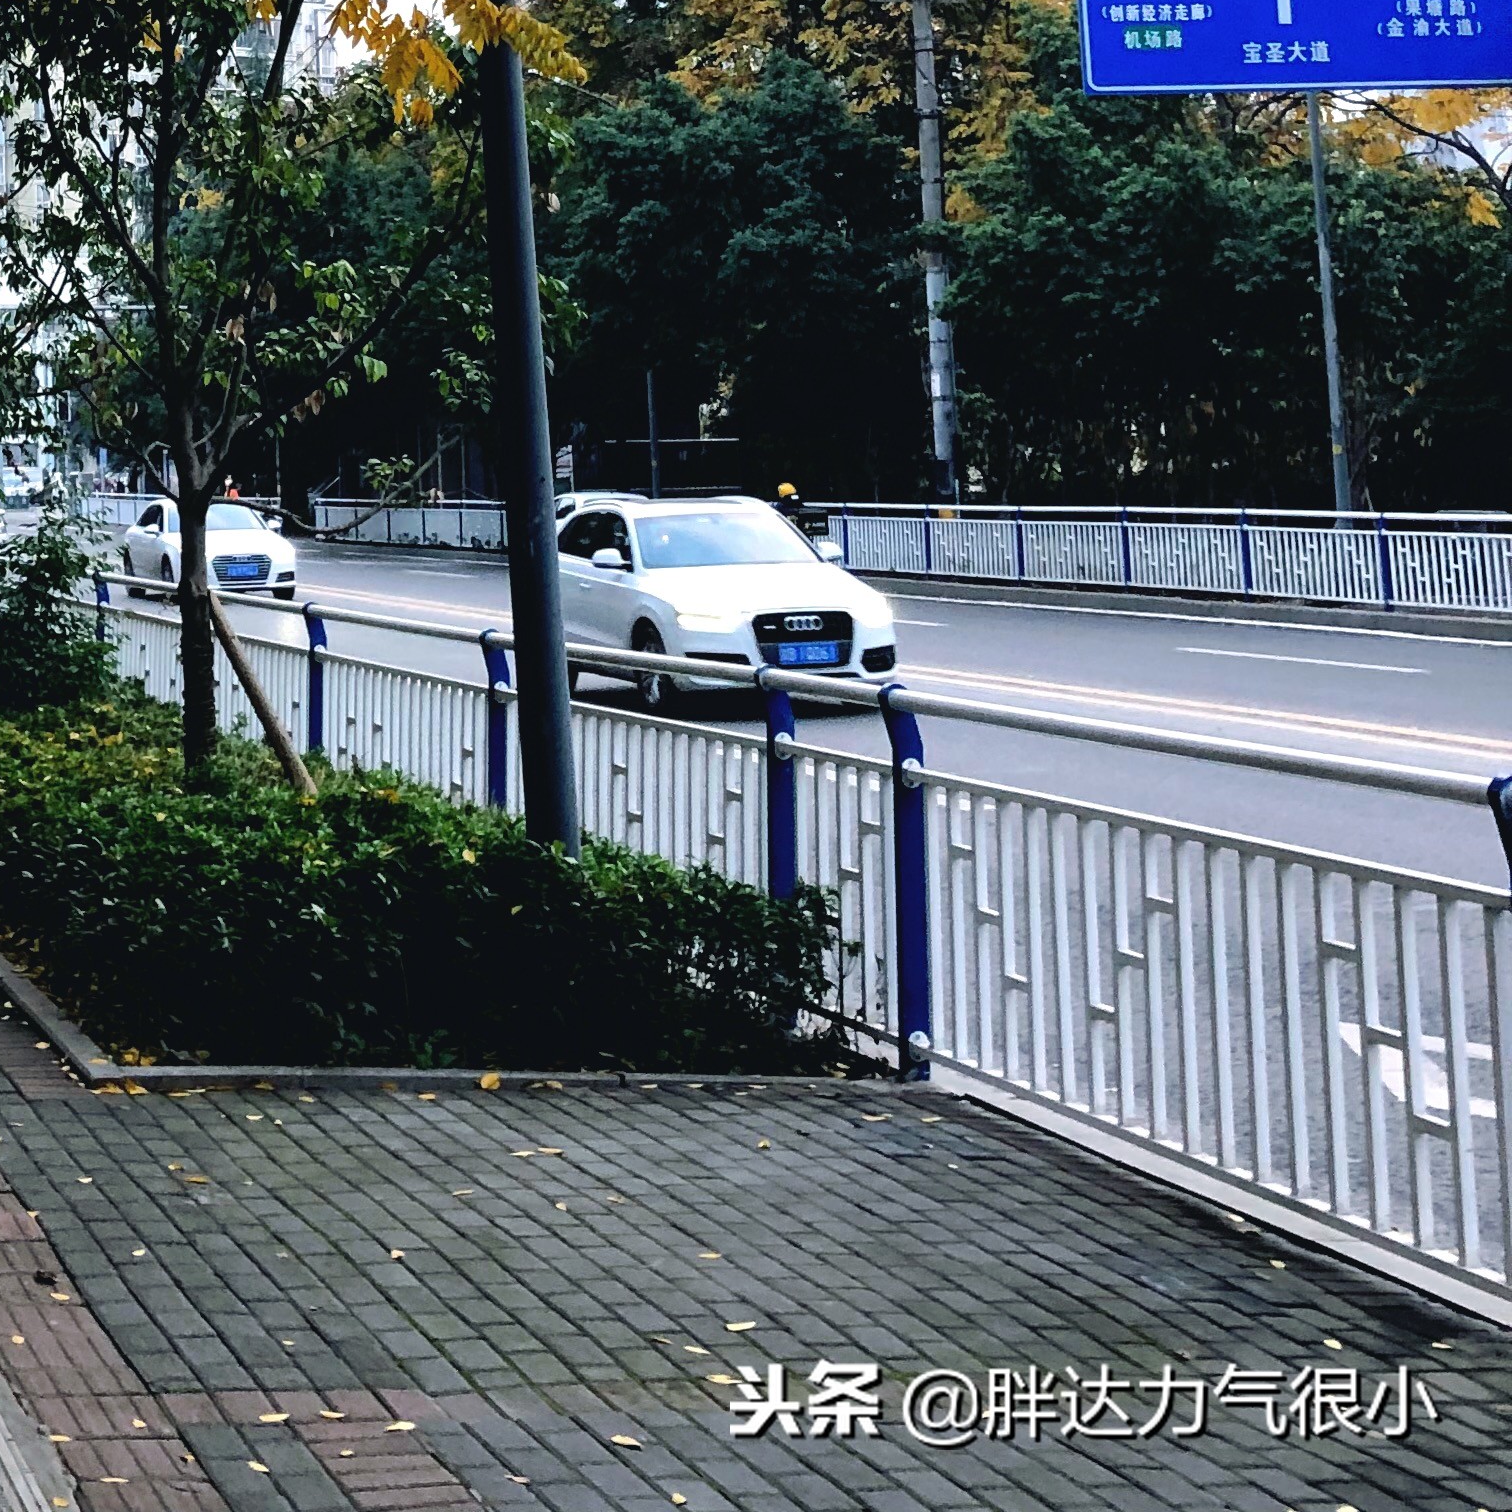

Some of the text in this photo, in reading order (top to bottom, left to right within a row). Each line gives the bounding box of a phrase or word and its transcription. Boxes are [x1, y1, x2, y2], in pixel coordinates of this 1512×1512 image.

[1124, 29, 1182, 49] 机场路
[1242, 41, 1330, 63] 宝圣大道
